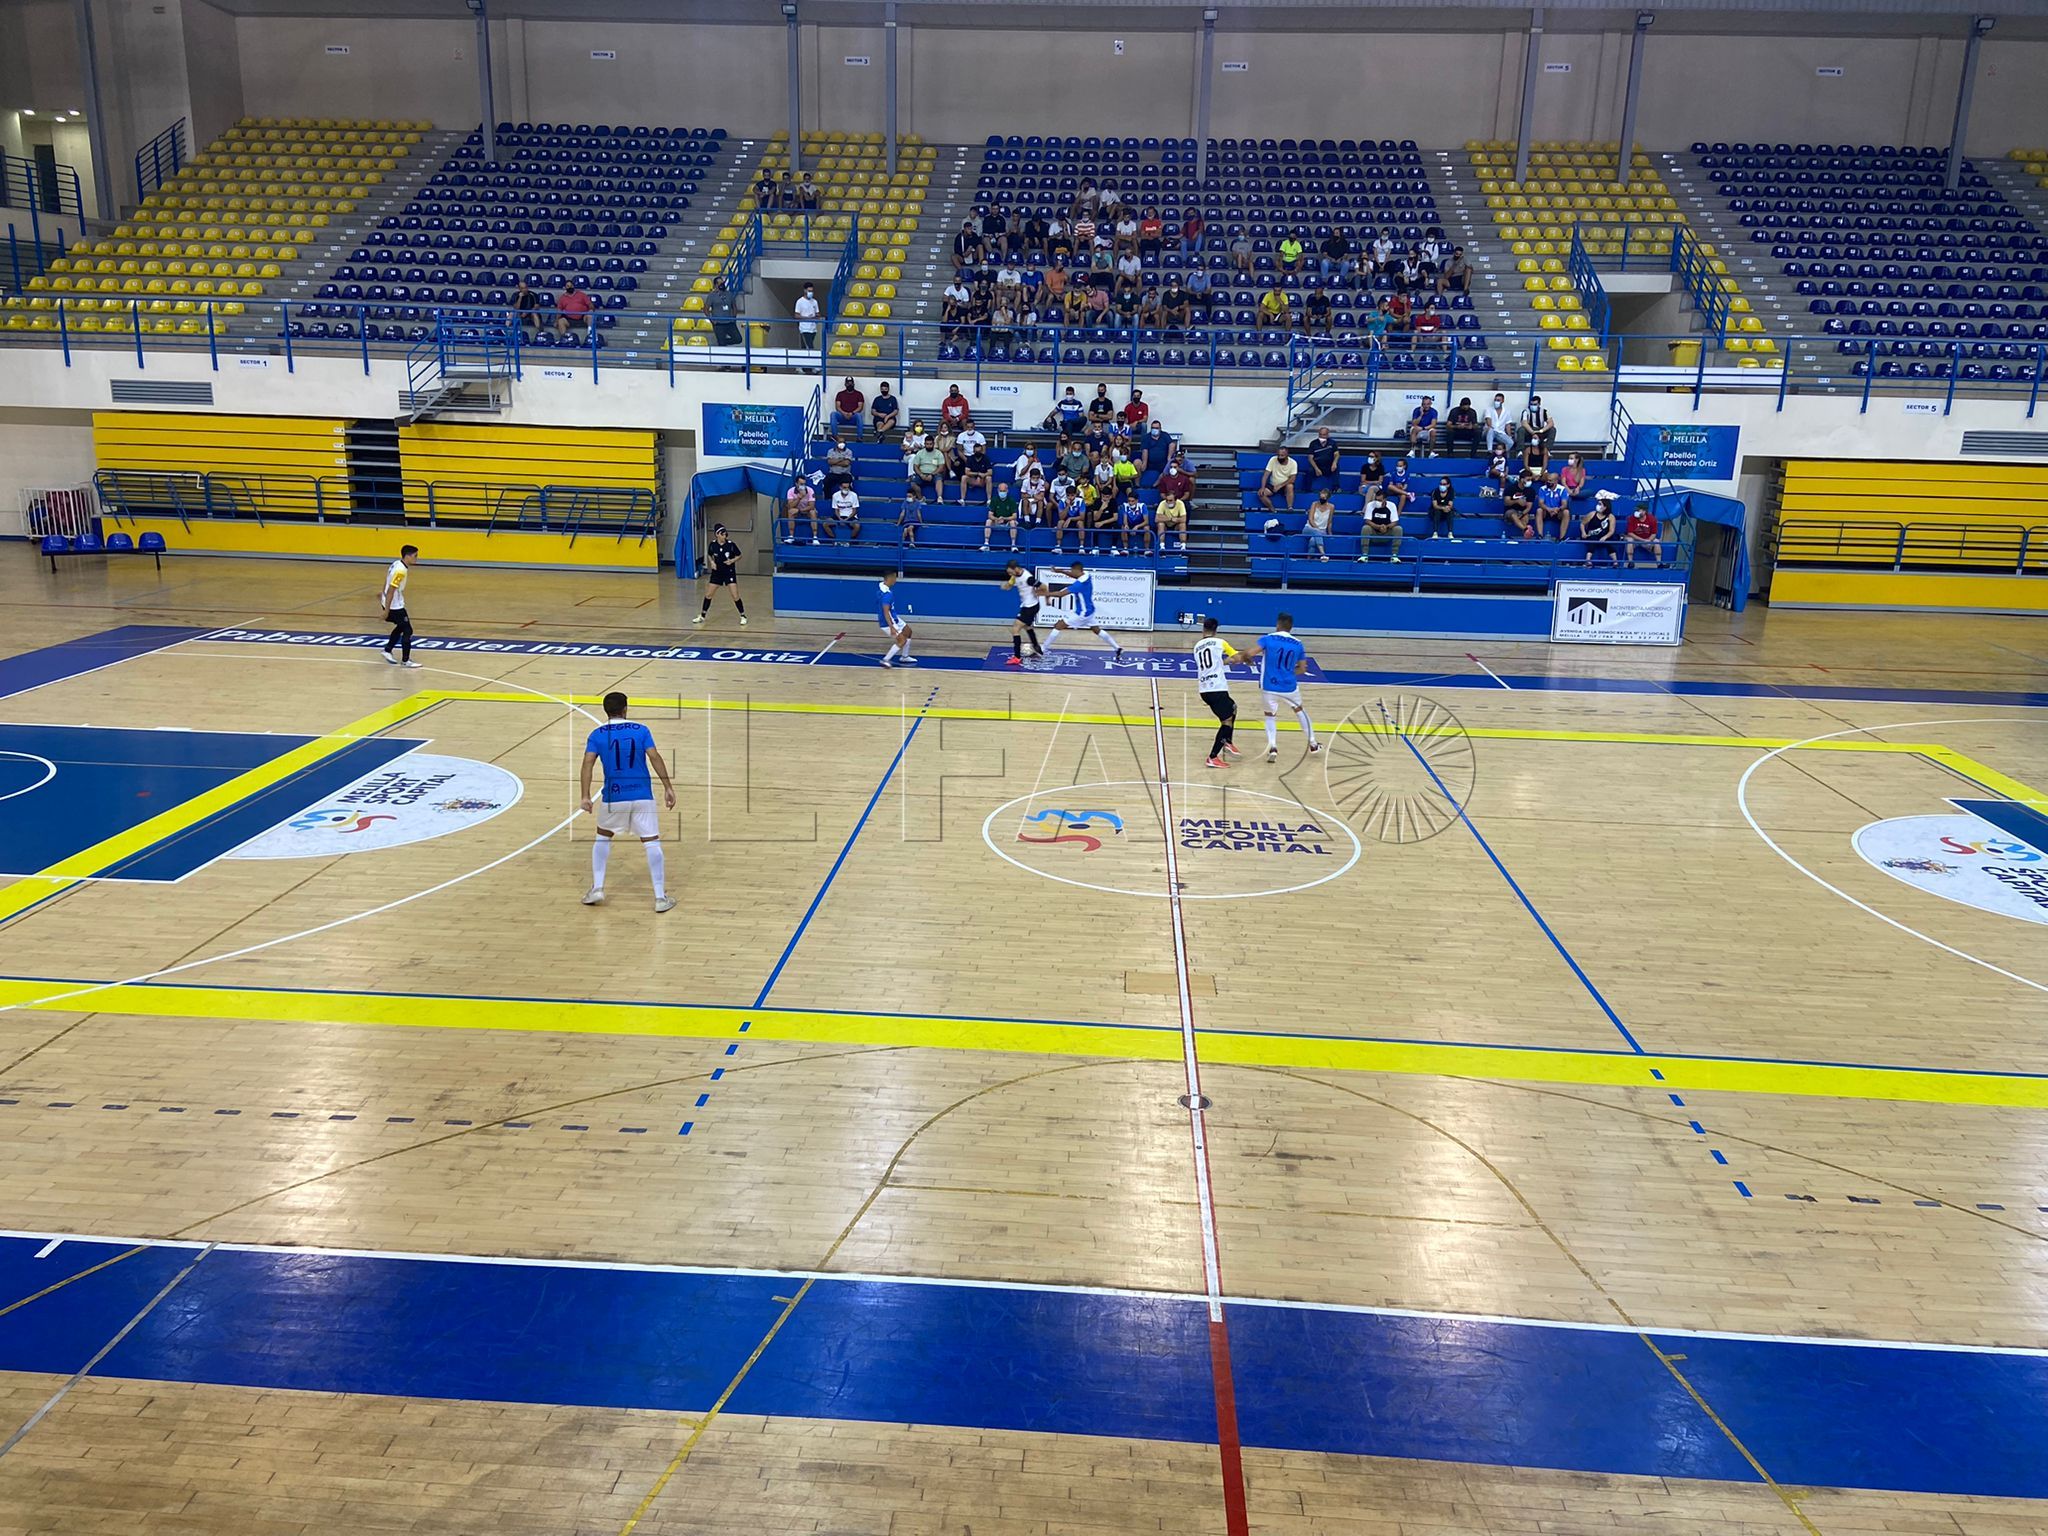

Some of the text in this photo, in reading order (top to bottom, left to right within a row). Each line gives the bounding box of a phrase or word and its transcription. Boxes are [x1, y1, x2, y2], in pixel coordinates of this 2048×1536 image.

[1931, 405, 1937, 413] 5
[745, 415, 776, 423] MELILLA
[738, 430, 768, 438] Pabellón
[1673, 435, 1708, 444] MELILLA
[719, 437, 789, 447] Javier Imbroda Ortiz
[1663, 451, 1697, 460] Pabellón
[1665, 460, 1697, 468] Imbroda
[1699, 460, 1718, 468] Ortiz
[1093, 597, 1138, 605] ARQUITECTOS
[213, 629, 391, 648] Pabellón
[527, 643, 701, 660] Imbroda
[711, 648, 811, 663] Ortiz
[1198, 647, 1213, 671] 10
[1277, 647, 1294, 672] 10
[599, 721, 642, 734] NEGRO
[609, 737, 637, 772] 17
[336, 771, 406, 803] MELILLA
[363, 777, 421, 804] SPORT
[391, 773, 457, 806] CAPITAL
[1180, 818, 1324, 834] MELILLA
[1180, 828, 1298, 843] SPORT
[1180, 839, 1333, 856] CAPITAL
